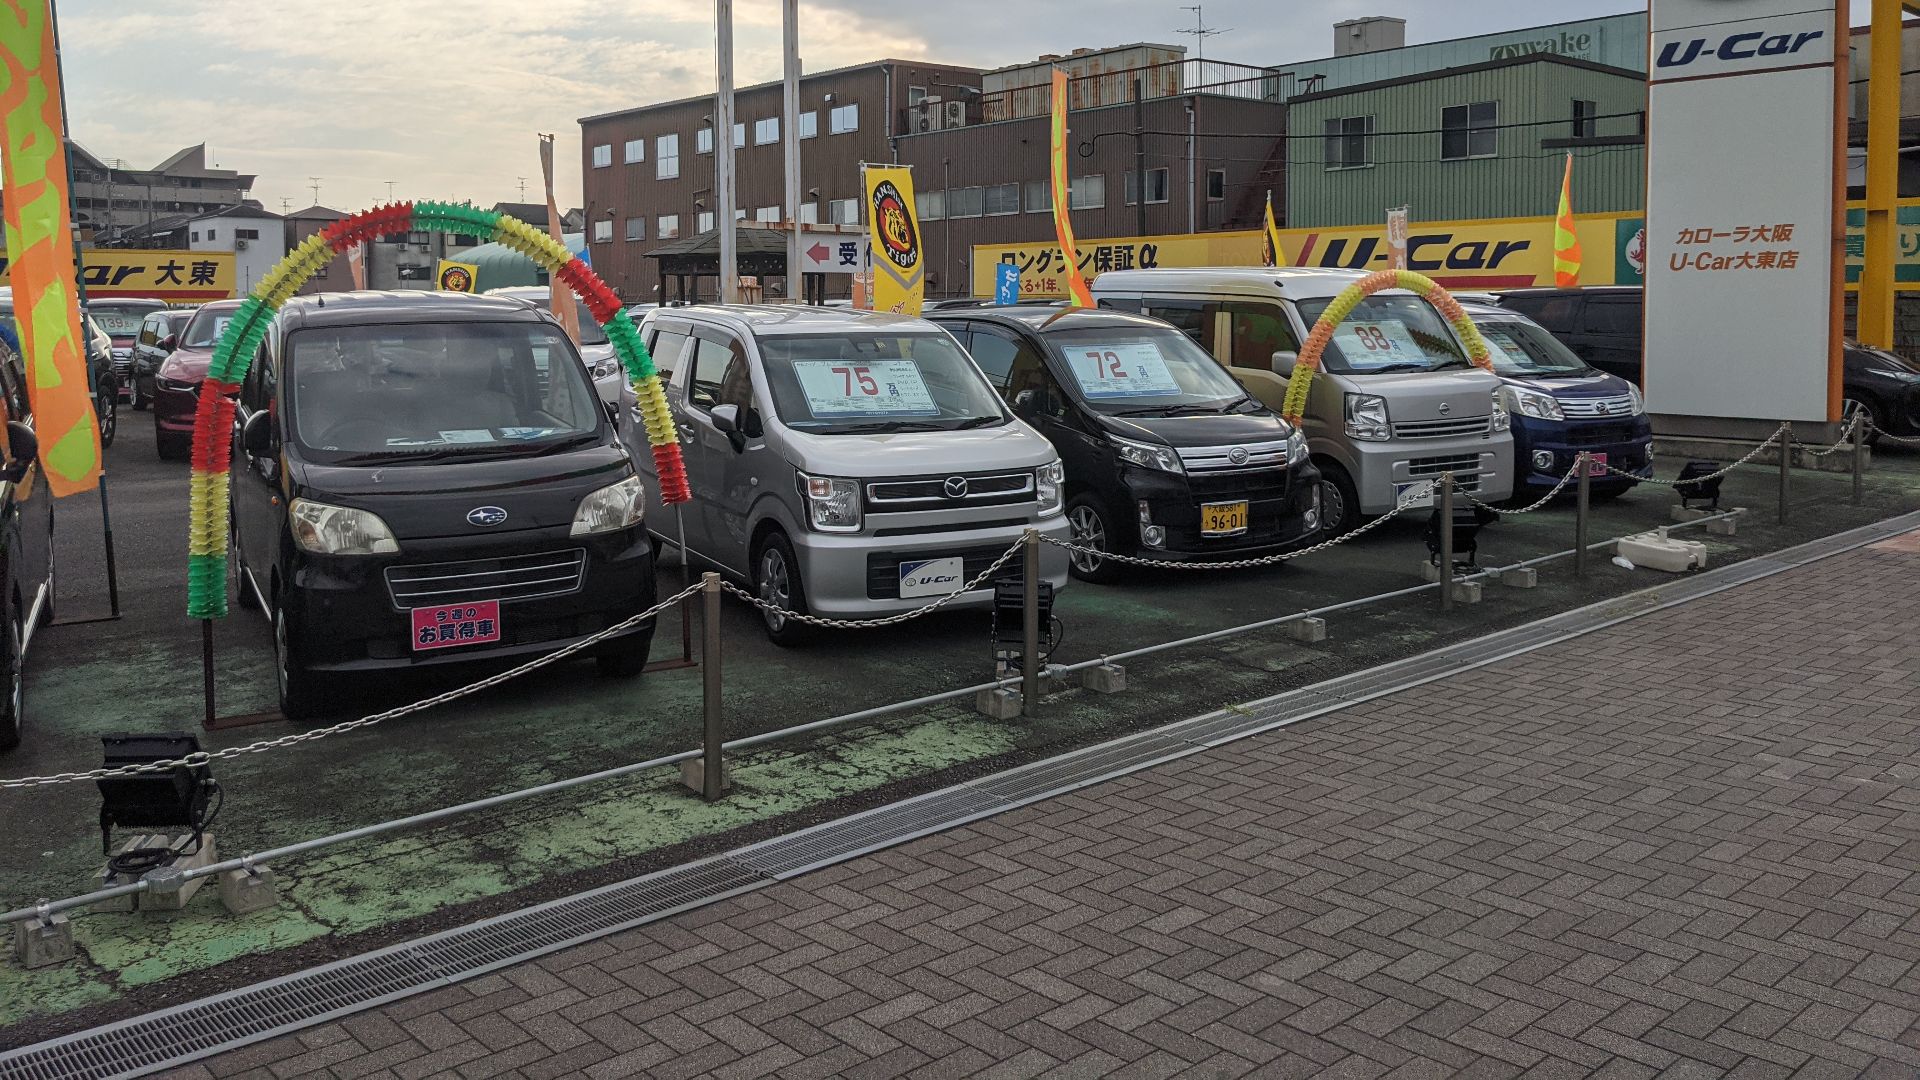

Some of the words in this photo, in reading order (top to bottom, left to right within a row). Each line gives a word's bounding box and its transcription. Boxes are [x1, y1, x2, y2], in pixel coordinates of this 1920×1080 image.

[1656, 30, 1824, 68] U-Car
[1676, 223, 1795, 245] カローラ大阪
[1320, 233, 1531, 271] U-Car
[1669, 250, 1799, 272] U-Car大東店
[154, 259, 219, 286] 大東
[1354, 321, 1391, 350] 88
[1086, 351, 1128, 379] 72
[831, 367, 879, 396] 75
[1211, 512, 1243, 530] 96-01
[919, 575, 959, 585] U-Car
[436, 607, 477, 621] 今週の
[419, 618, 495, 644] お買得車
